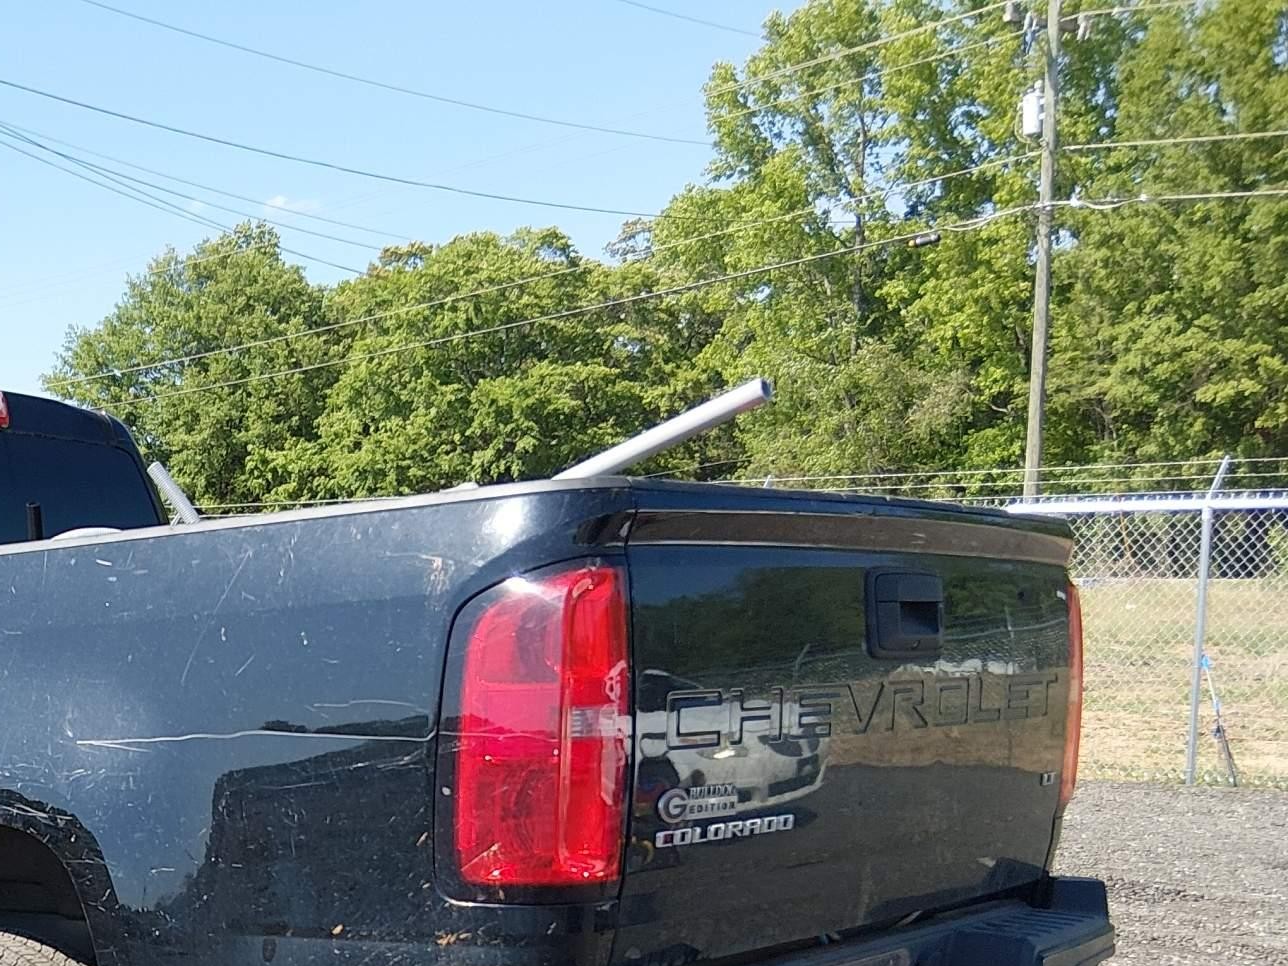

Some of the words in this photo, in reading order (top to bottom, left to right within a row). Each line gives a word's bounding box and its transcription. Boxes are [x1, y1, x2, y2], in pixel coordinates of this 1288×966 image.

[666, 672, 1058, 750] CHEVROLET
[689, 784, 737, 800] BULLDOG
[688, 801, 736, 815] EDITION
[655, 814, 795, 848] COLORADO
